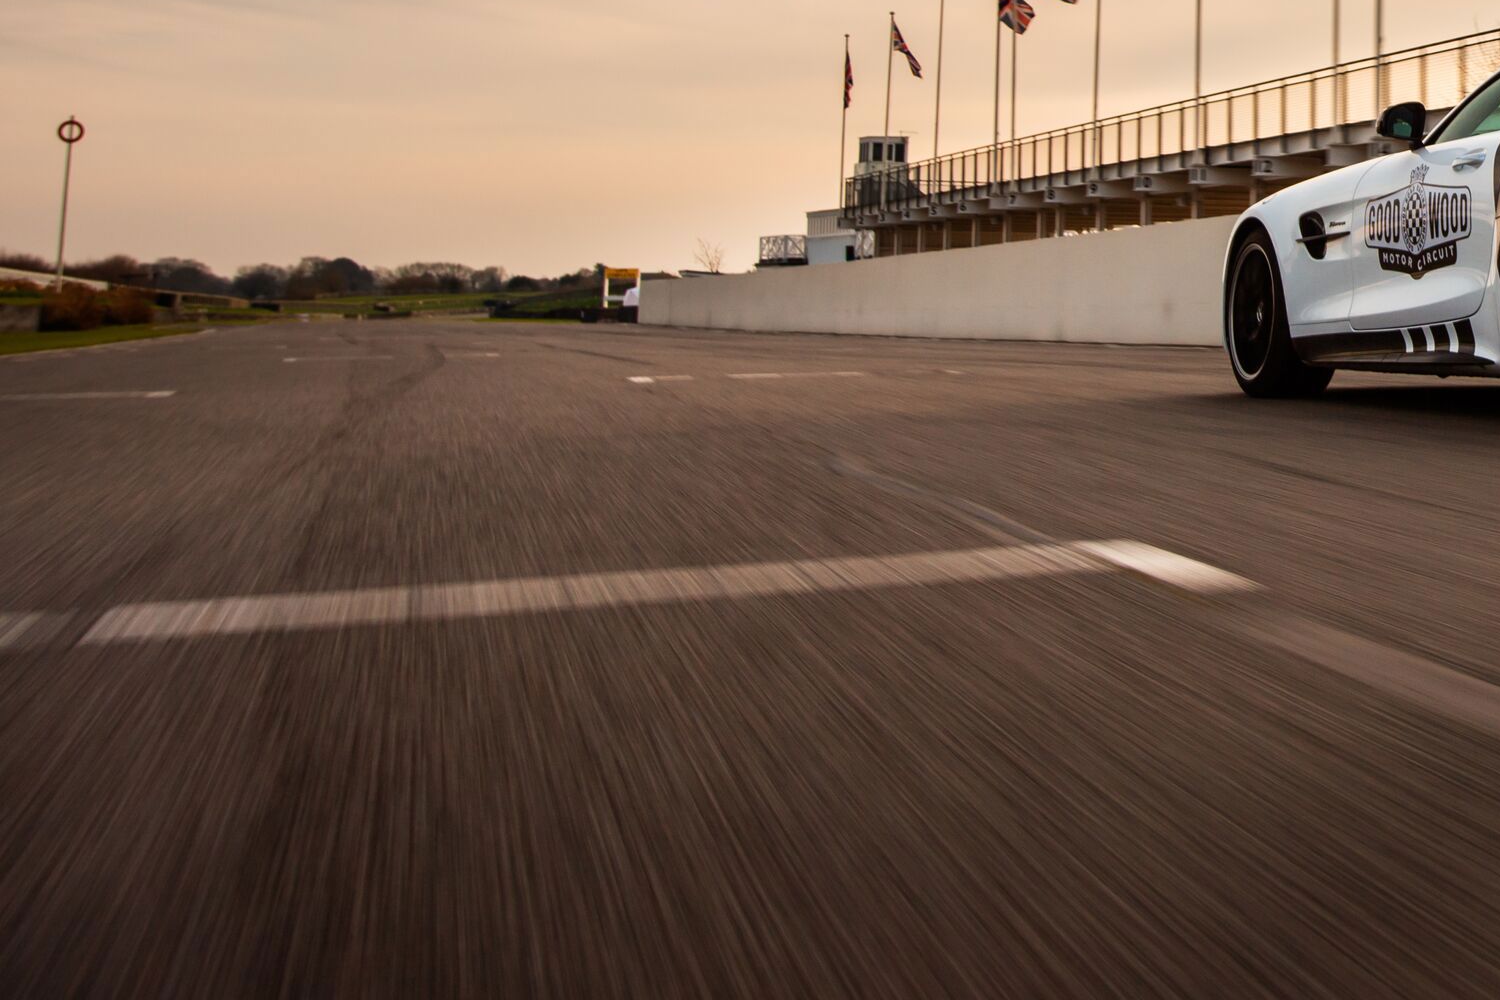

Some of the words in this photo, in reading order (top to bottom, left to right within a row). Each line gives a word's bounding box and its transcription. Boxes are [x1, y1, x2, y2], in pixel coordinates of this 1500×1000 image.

[1089, 183, 1098, 194] 9
[1009, 194, 1017, 205] 7
[930, 205, 937, 216] 5
[858, 216, 865, 225] 2
[879, 213, 886, 222] 3
[1368, 198, 1401, 243] GOOD
[1428, 191, 1468, 239] WOOD
[1382, 252, 1413, 269] MOTOR
[1417, 245, 1454, 271] CIRCUIT
